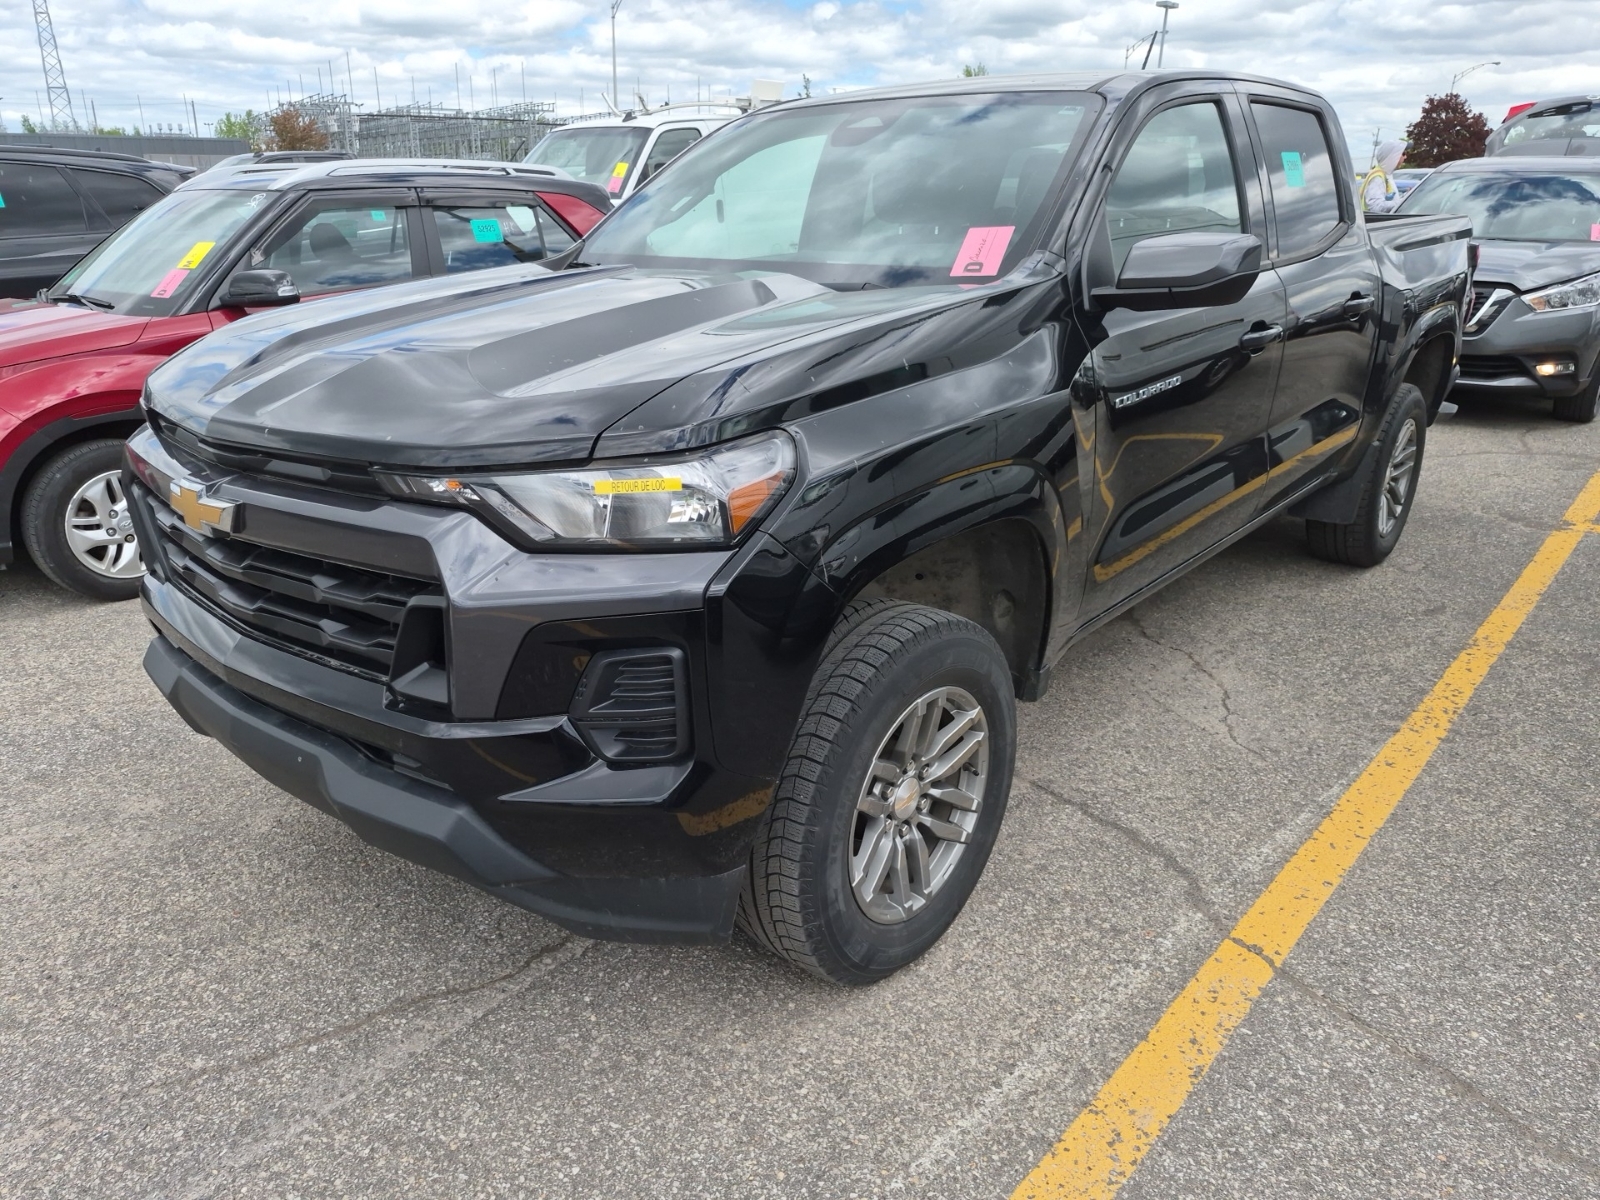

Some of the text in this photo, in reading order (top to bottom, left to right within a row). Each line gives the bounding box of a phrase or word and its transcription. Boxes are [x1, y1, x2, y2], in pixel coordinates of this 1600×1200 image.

[963, 261, 984, 273] D
[1115, 375, 1182, 409] COLORADO
[611, 480, 666, 492] RETOUR DE LOC
